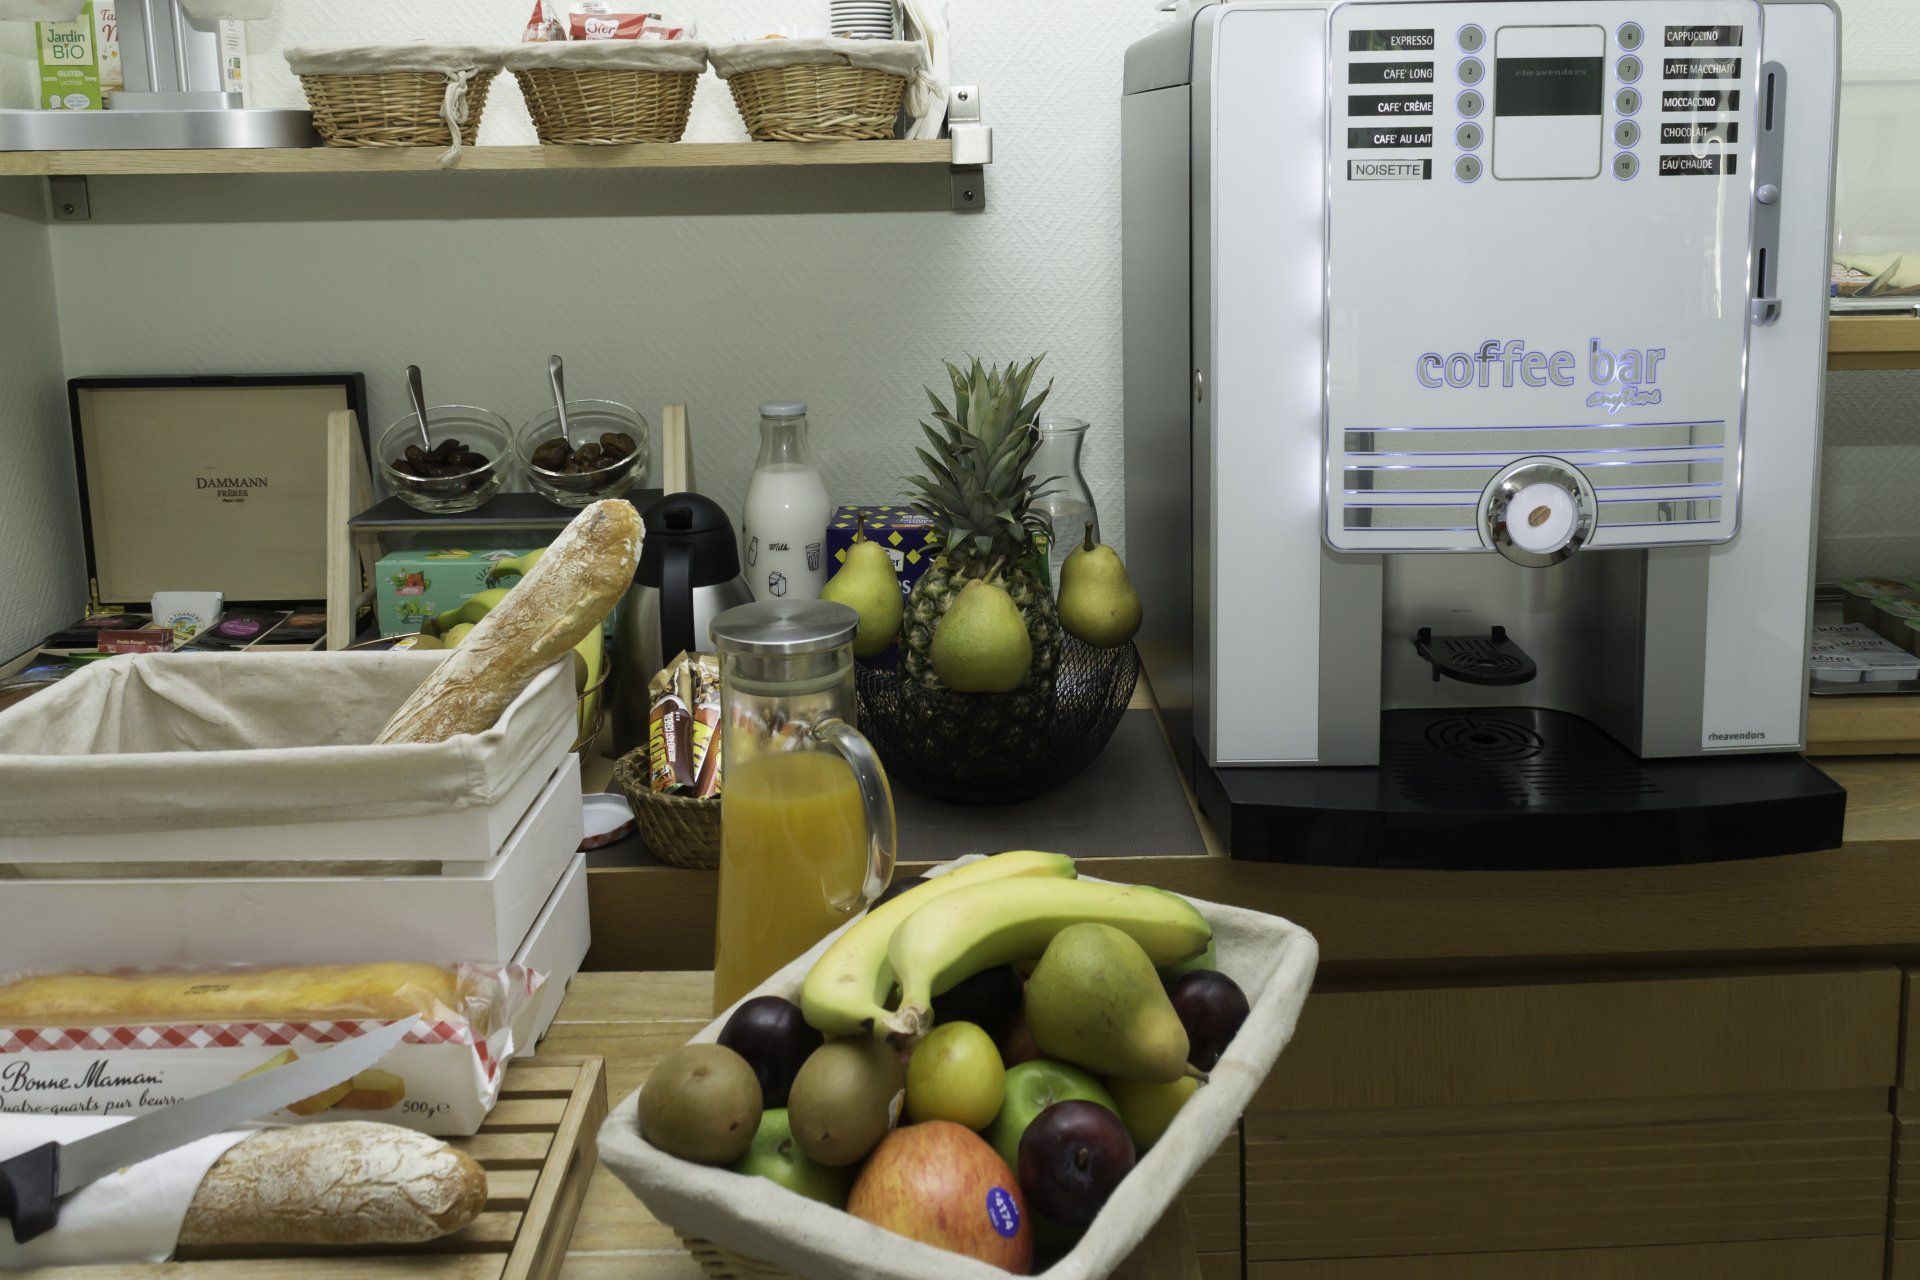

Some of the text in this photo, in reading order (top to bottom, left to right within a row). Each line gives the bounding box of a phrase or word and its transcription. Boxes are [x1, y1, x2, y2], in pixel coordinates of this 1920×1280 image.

[47, 29, 85, 43] Jardin
[1390, 35, 1433, 46] EXPRESSO
[1666, 30, 1719, 42] CAPPUCCINO
[1409, 68, 1433, 79] LONG
[1665, 63, 1736, 74] LATTE MACCHIATO
[1663, 97, 1716, 107] MOCCACCINO
[1663, 127, 1708, 138] CHOCOLAIT
[1400, 134, 1412, 144] AU
[1414, 133, 1433, 144] LAIT
[1621, 162, 1630, 170] 10
[1661, 159, 1713, 170] EAU CHAUDE
[1355, 164, 1421, 177] NOISETTE
[1416, 337, 1666, 388] coffee bar
[196, 477, 268, 489] DAMMANN
[217, 489, 249, 497] FRÈRES
[768, 542, 791, 552] Milk
[1708, 731, 1766, 741] rheavendors
[649, 718, 667, 770] LION
[2, 1058, 162, 1093] Bonne Maman
[104, 1101, 134, 1115] pur
